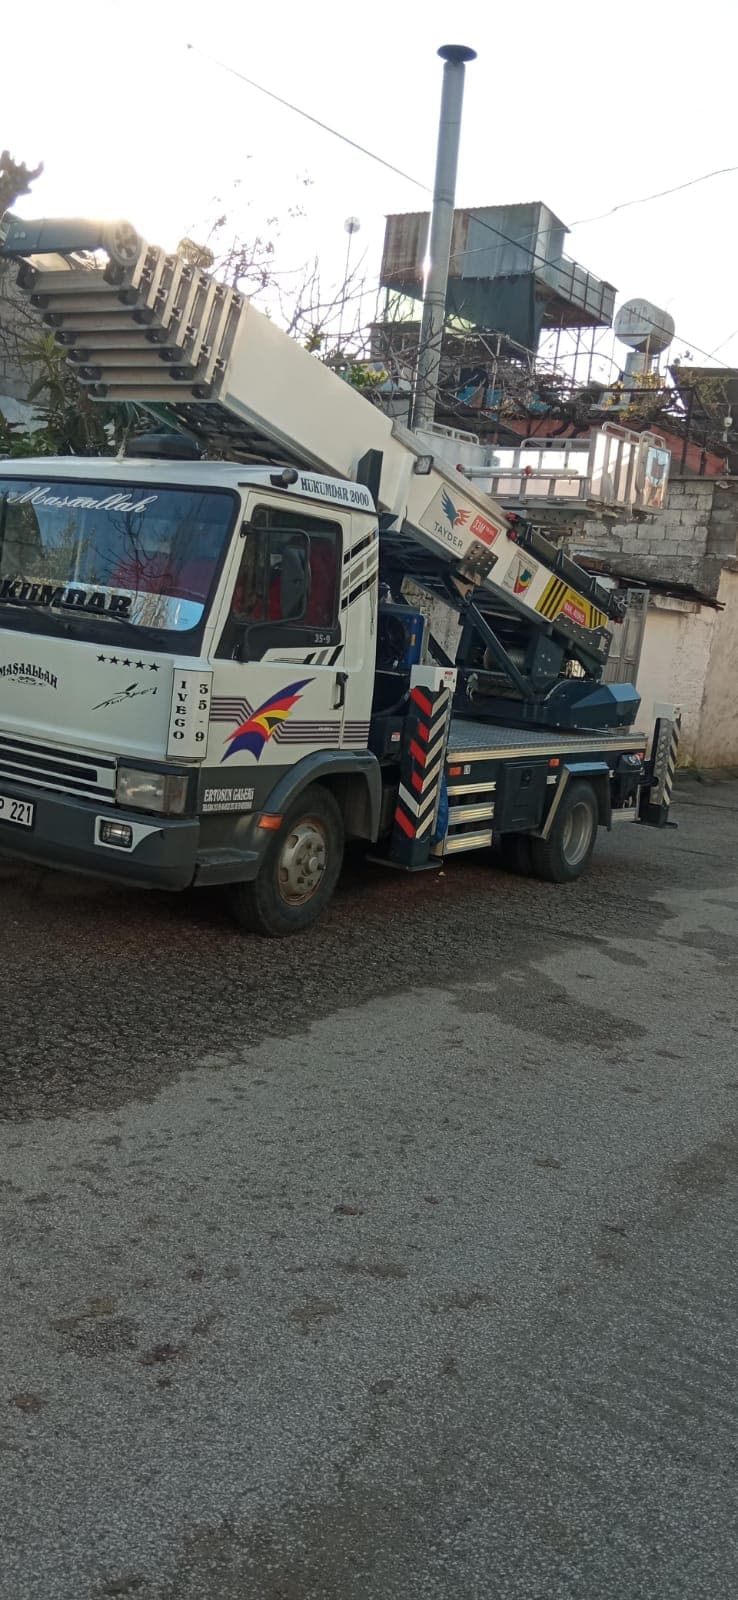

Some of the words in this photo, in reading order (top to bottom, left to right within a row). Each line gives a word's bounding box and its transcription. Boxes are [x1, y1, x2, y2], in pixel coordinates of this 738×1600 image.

[350, 489, 370, 507] 2000
[433, 521, 464, 550] TAYDER
[10, 801, 31, 824] 221
